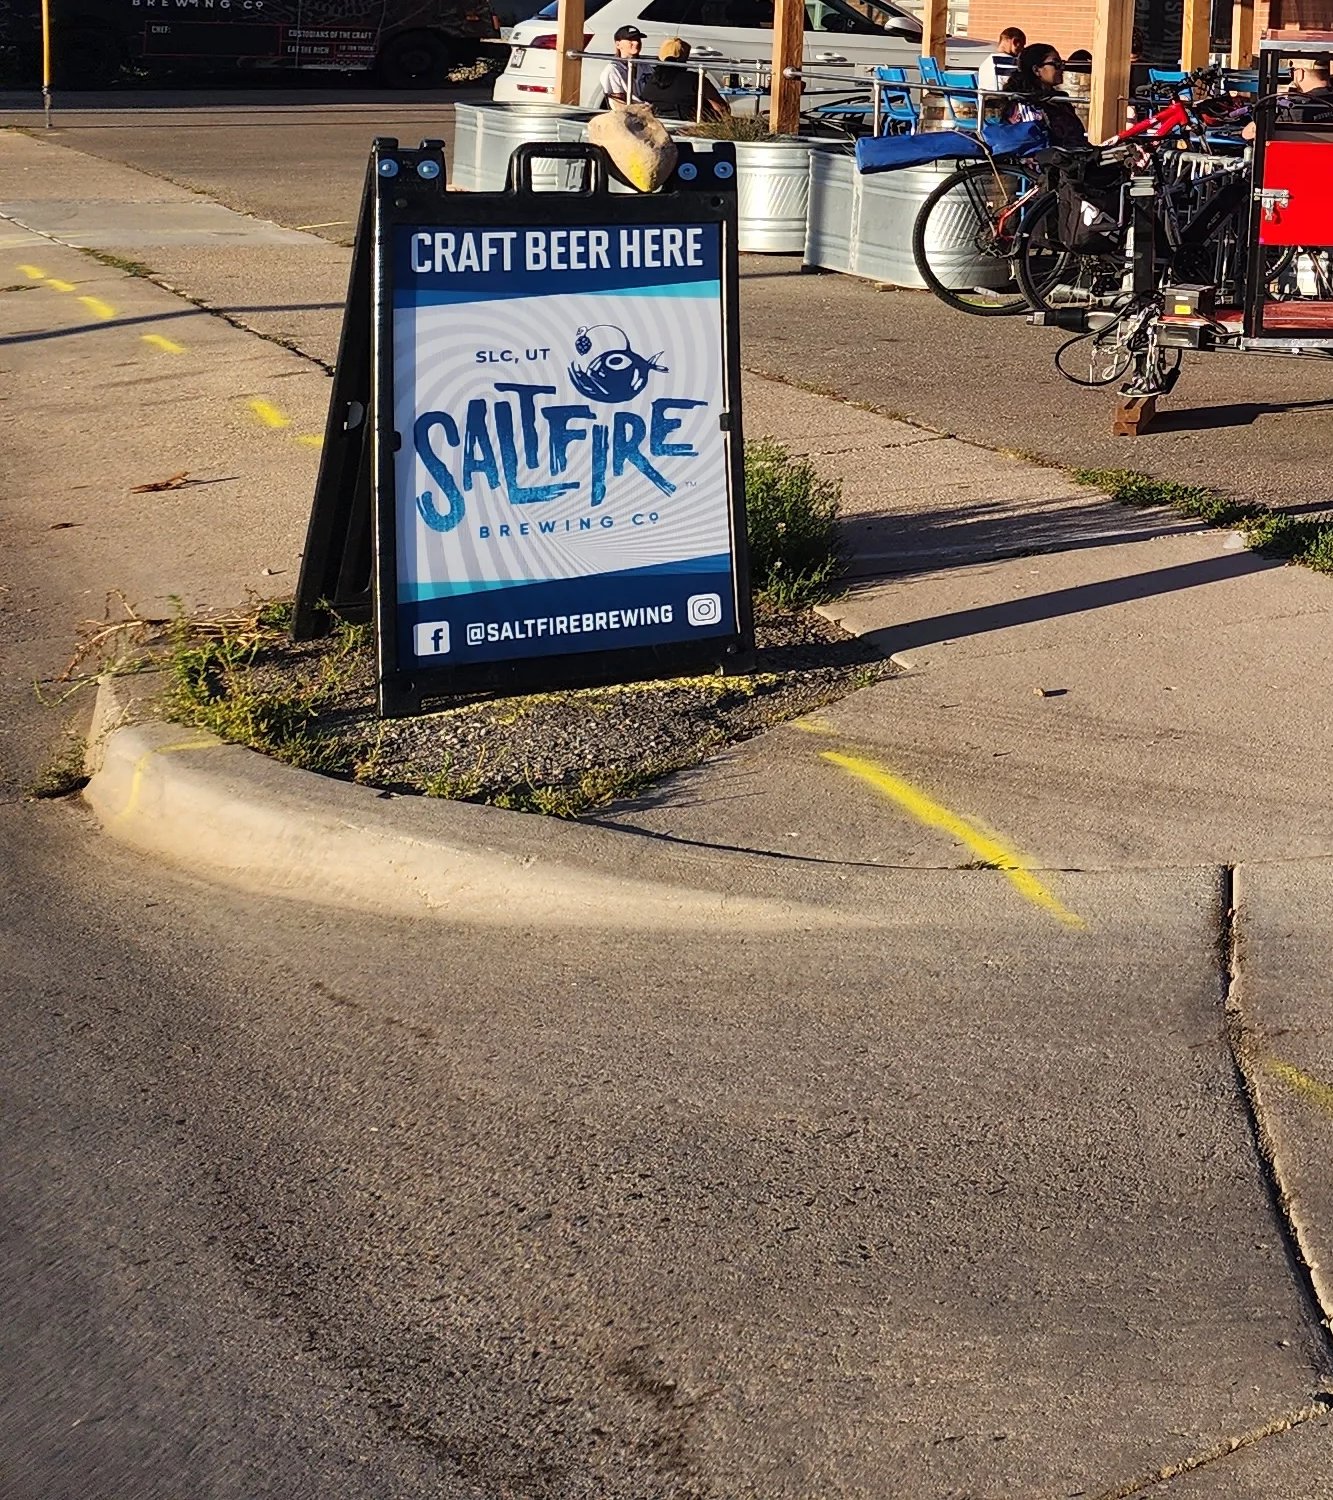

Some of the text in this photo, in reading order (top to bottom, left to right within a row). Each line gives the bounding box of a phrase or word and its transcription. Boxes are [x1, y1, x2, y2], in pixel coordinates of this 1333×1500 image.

[151, 25, 171, 33] CHEF:
[288, 29, 329, 38] CUSTODIANS
[329, 30, 338, 39] OF
[339, 31, 350, 39] THE
[410, 228, 704, 273] CRAFT BEER HERE
[475, 348, 551, 364] SLC, UT
[414, 382, 708, 533] SALTFIRE
[479, 515, 614, 539] BREWING
[466, 604, 673, 646] @SALTFIREBREWING
